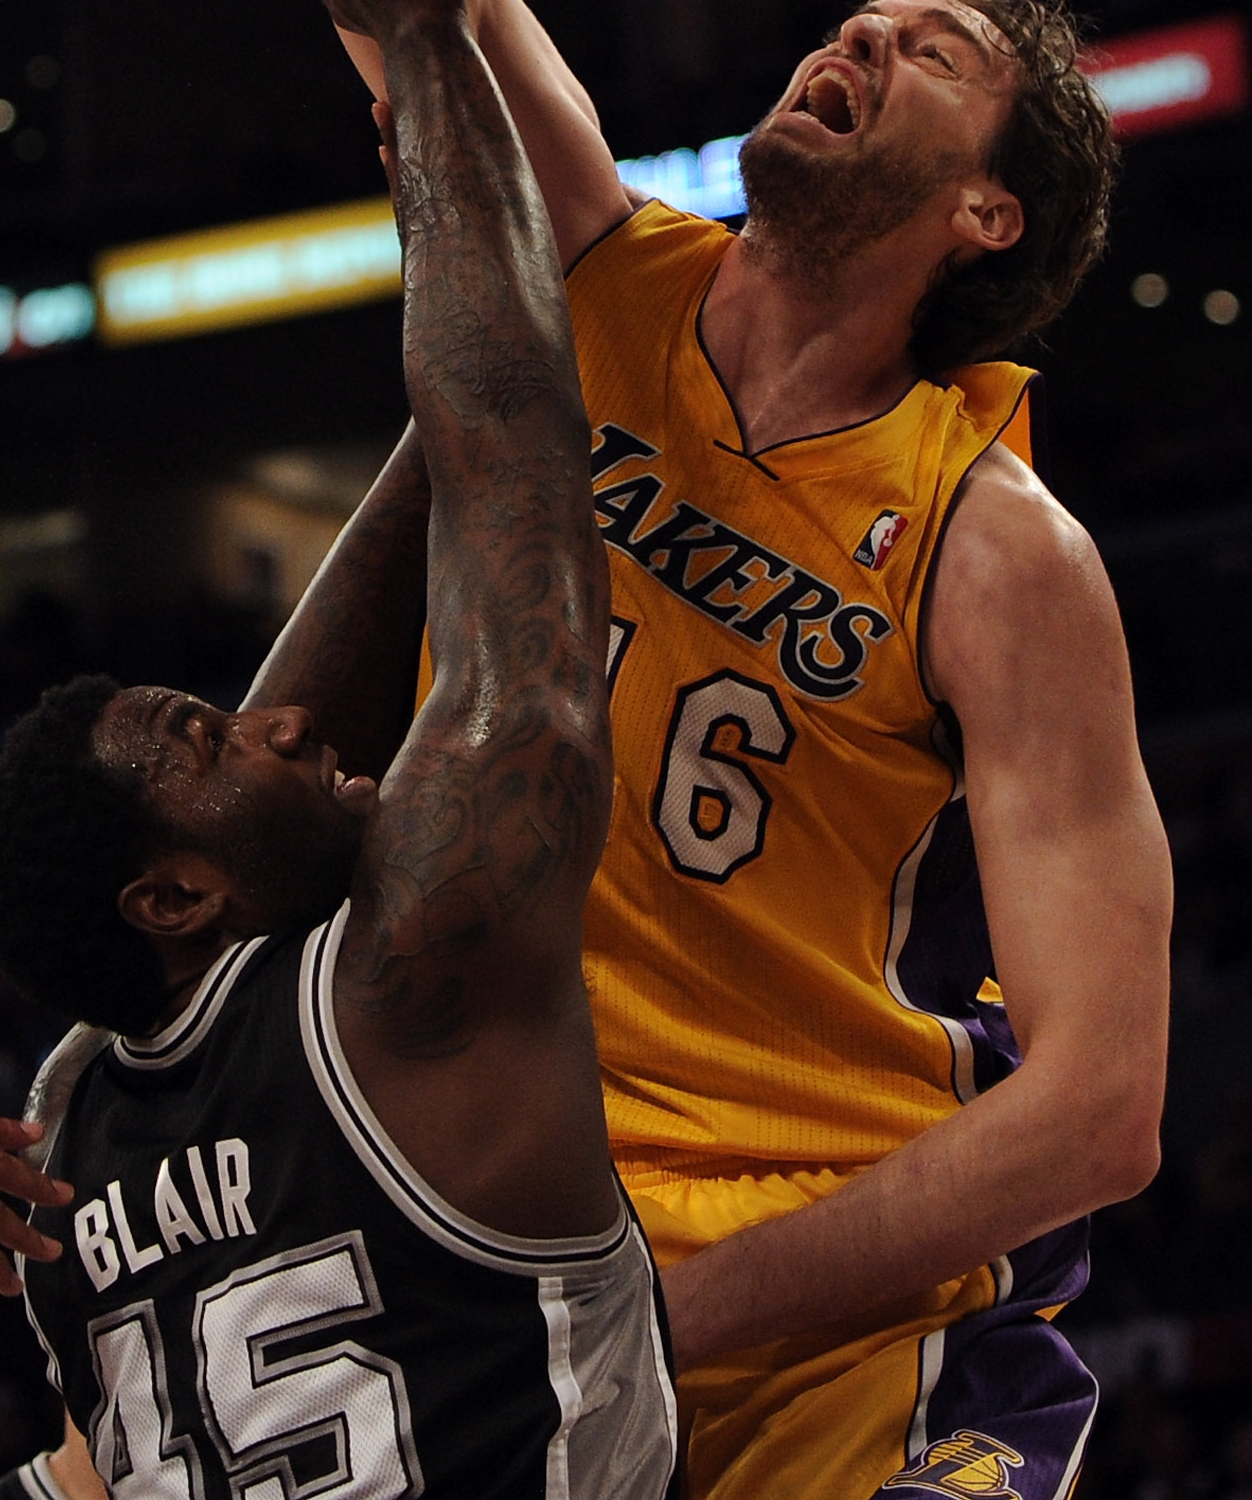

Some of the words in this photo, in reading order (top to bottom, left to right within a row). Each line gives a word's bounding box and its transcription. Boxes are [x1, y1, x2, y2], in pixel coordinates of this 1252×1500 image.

[854, 549, 874, 565] NBA
[605, 615, 797, 886] 6
[73, 1137, 257, 1293] BLAIR
[87, 1229, 425, 1500] 45
